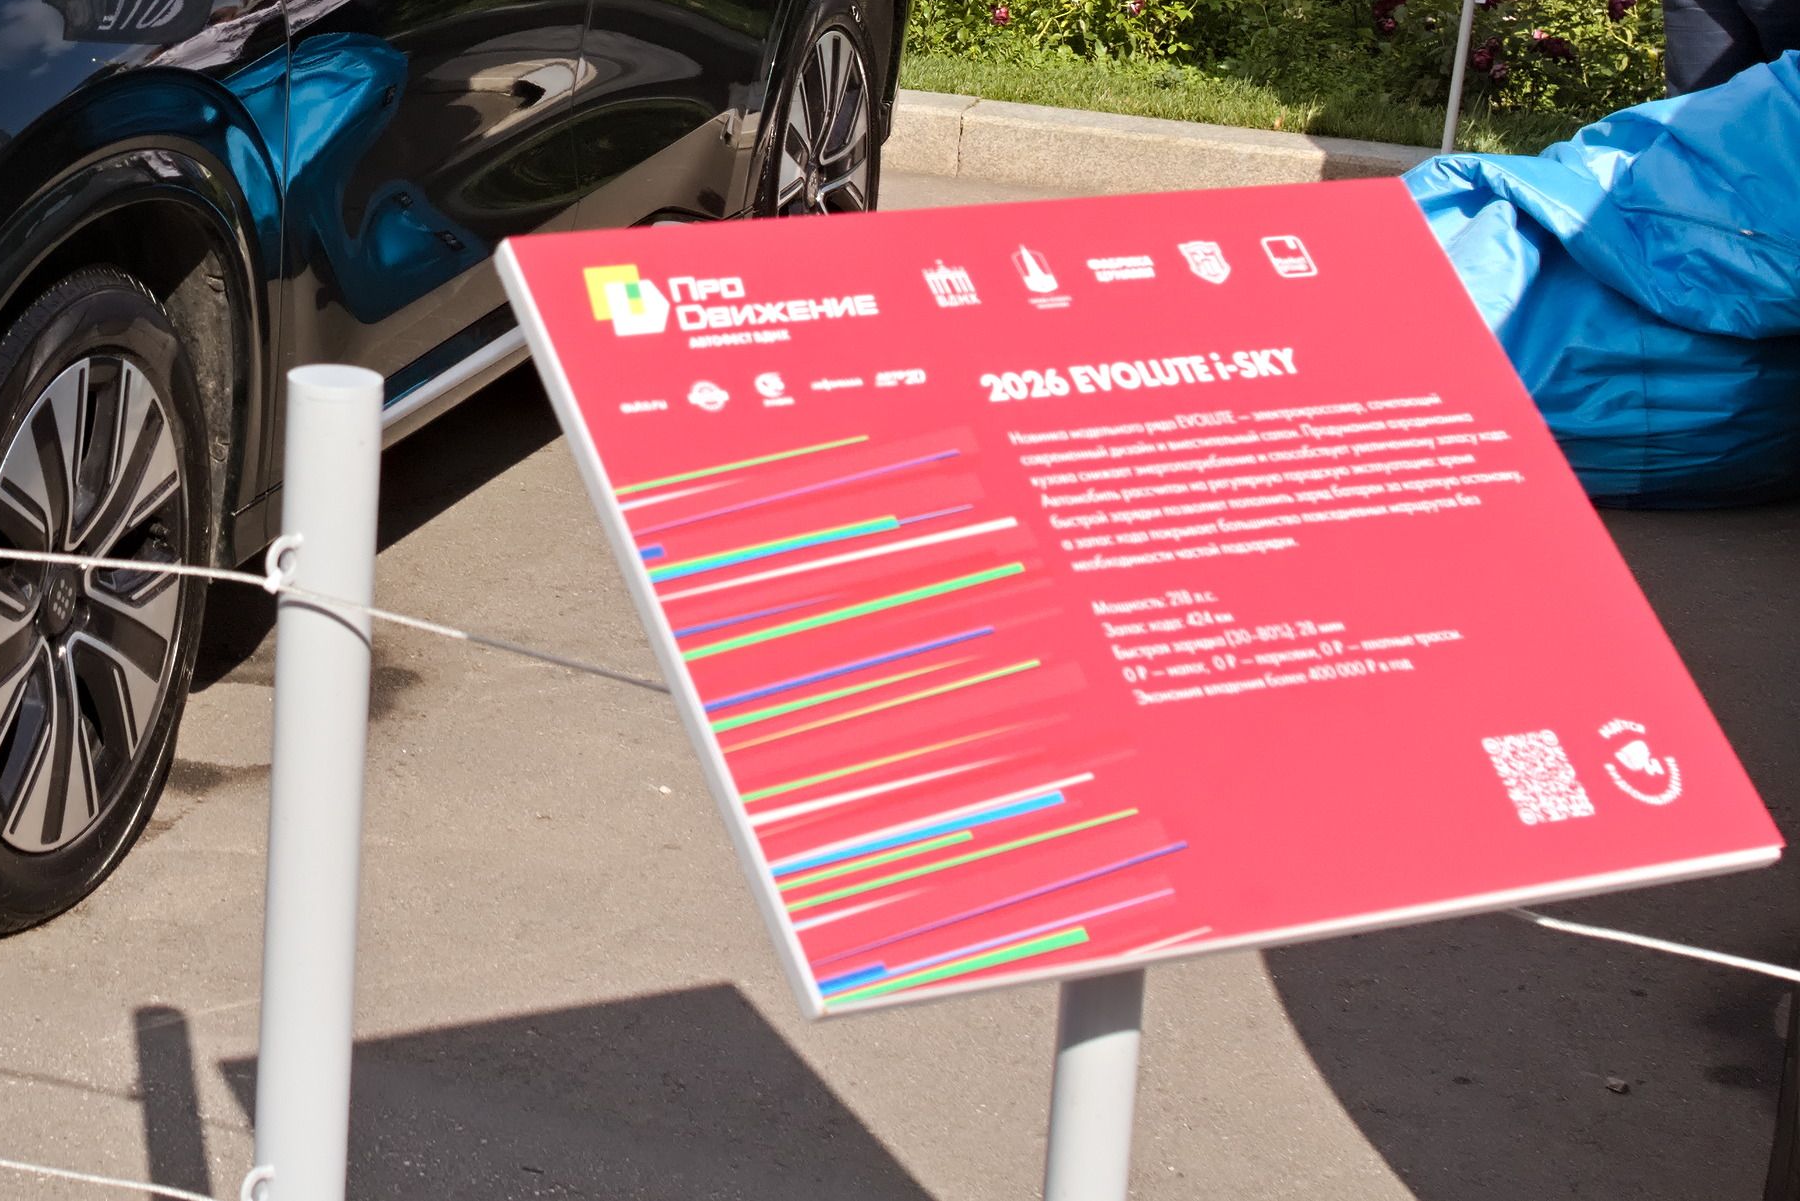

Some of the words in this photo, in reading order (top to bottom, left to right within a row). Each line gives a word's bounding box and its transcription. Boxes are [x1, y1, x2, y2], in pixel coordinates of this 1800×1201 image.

[934, 291, 980, 307] ВДНХ
[979, 368, 1069, 402] 2026
[1068, 355, 1214, 393] EVOLUTE
[1209, 347, 1297, 380] i-SKY
[1174, 410, 1236, 428] EVOLUTE
